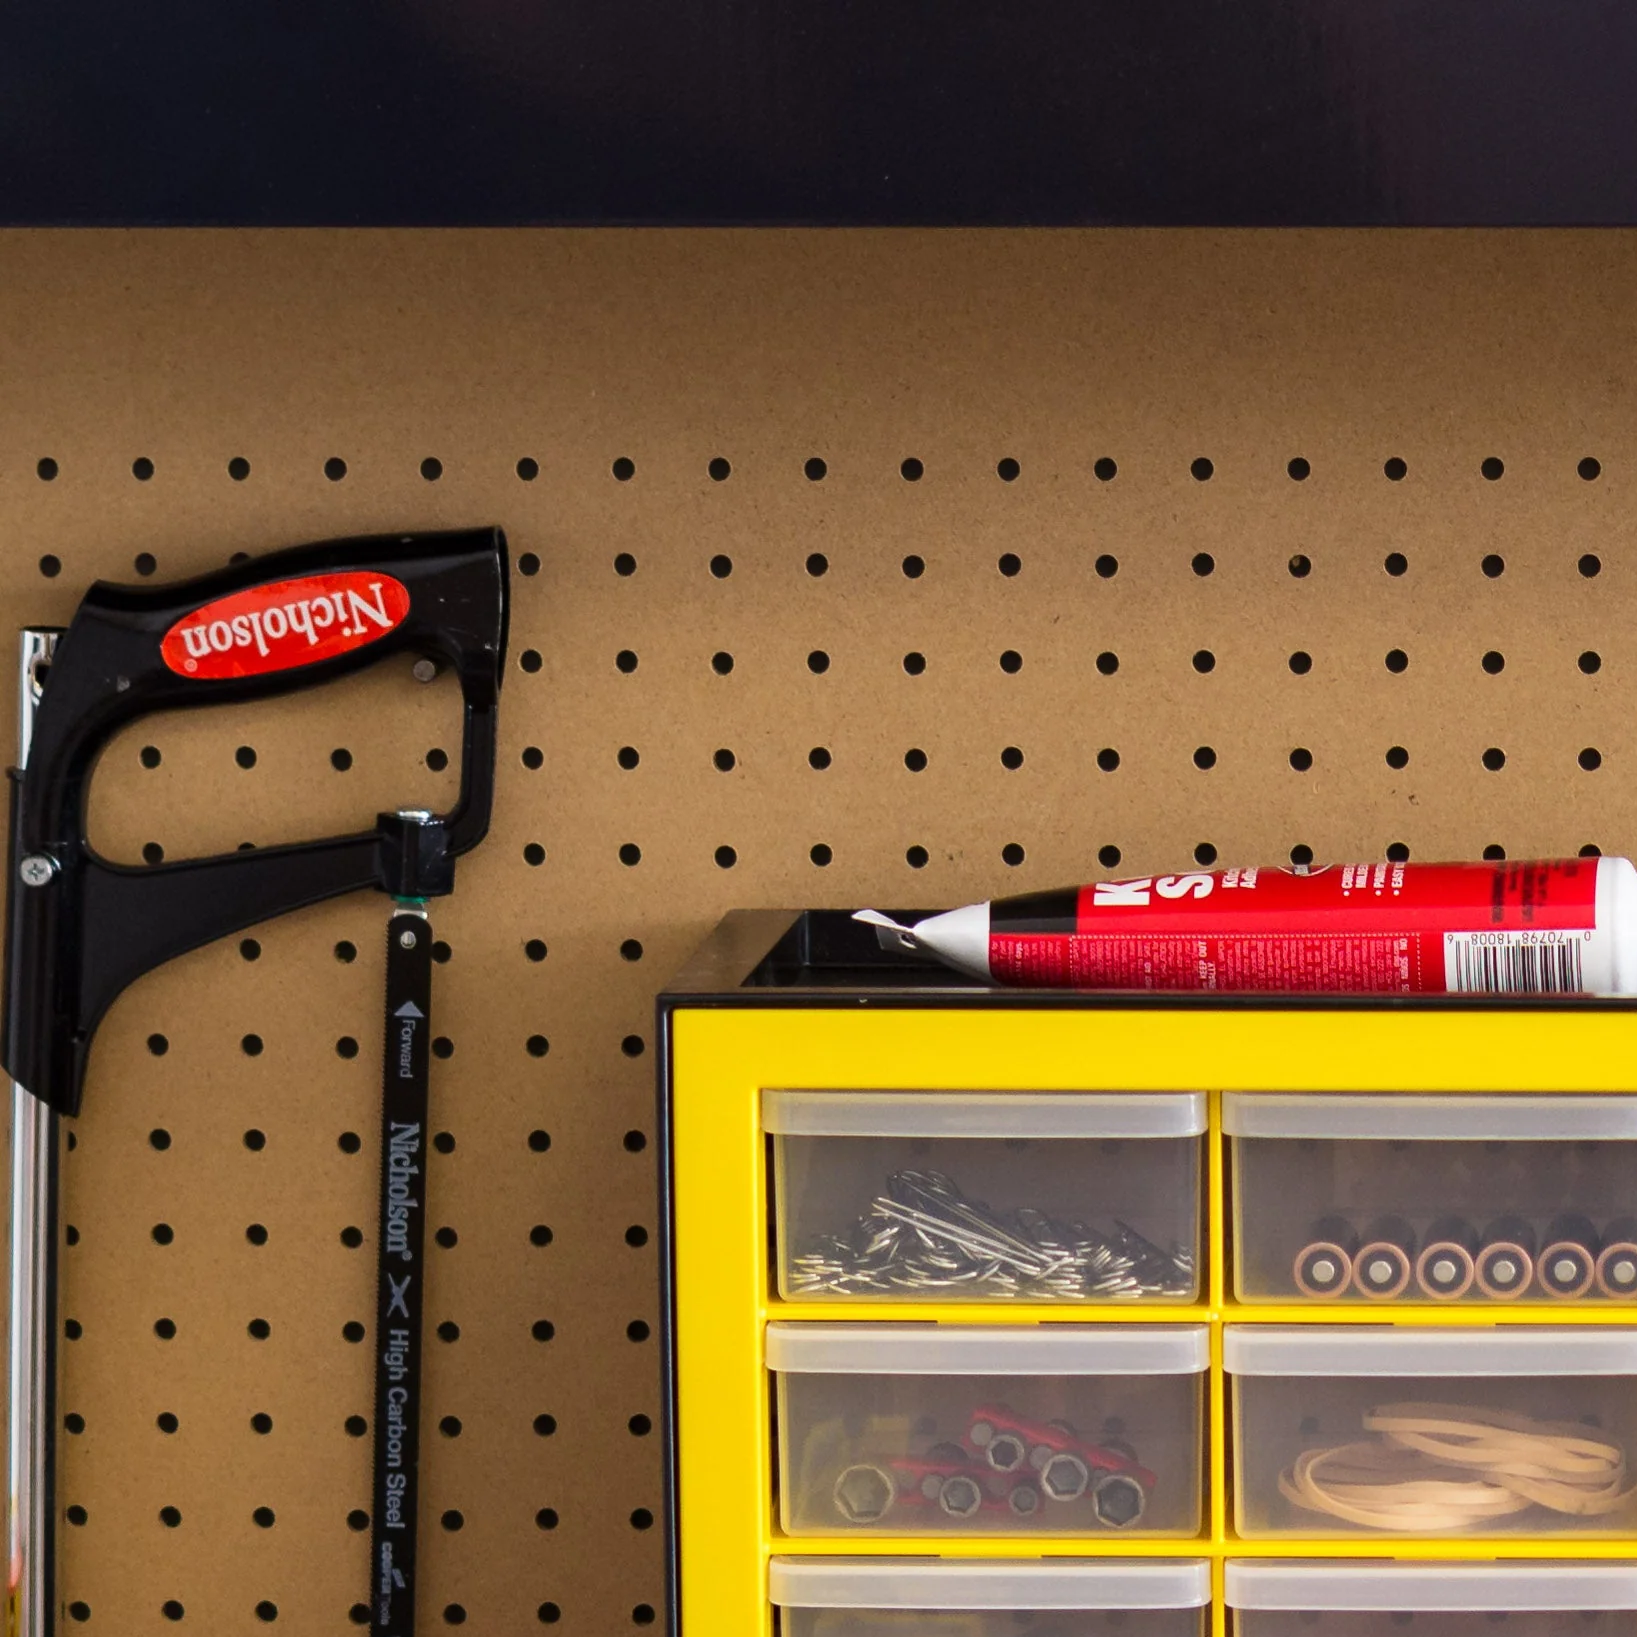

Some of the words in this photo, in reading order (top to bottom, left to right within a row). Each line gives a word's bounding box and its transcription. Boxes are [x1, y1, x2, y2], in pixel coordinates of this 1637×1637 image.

[181, 583, 394, 657] Nicholson
[1470, 933, 1512, 945] 18008
[1522, 932, 1564, 945] 70798
[400, 1019, 416, 1078] Forward
[384, 1329, 410, 1380] High
[387, 1386, 408, 1467] Carbon
[386, 1473, 406, 1528] Steel
